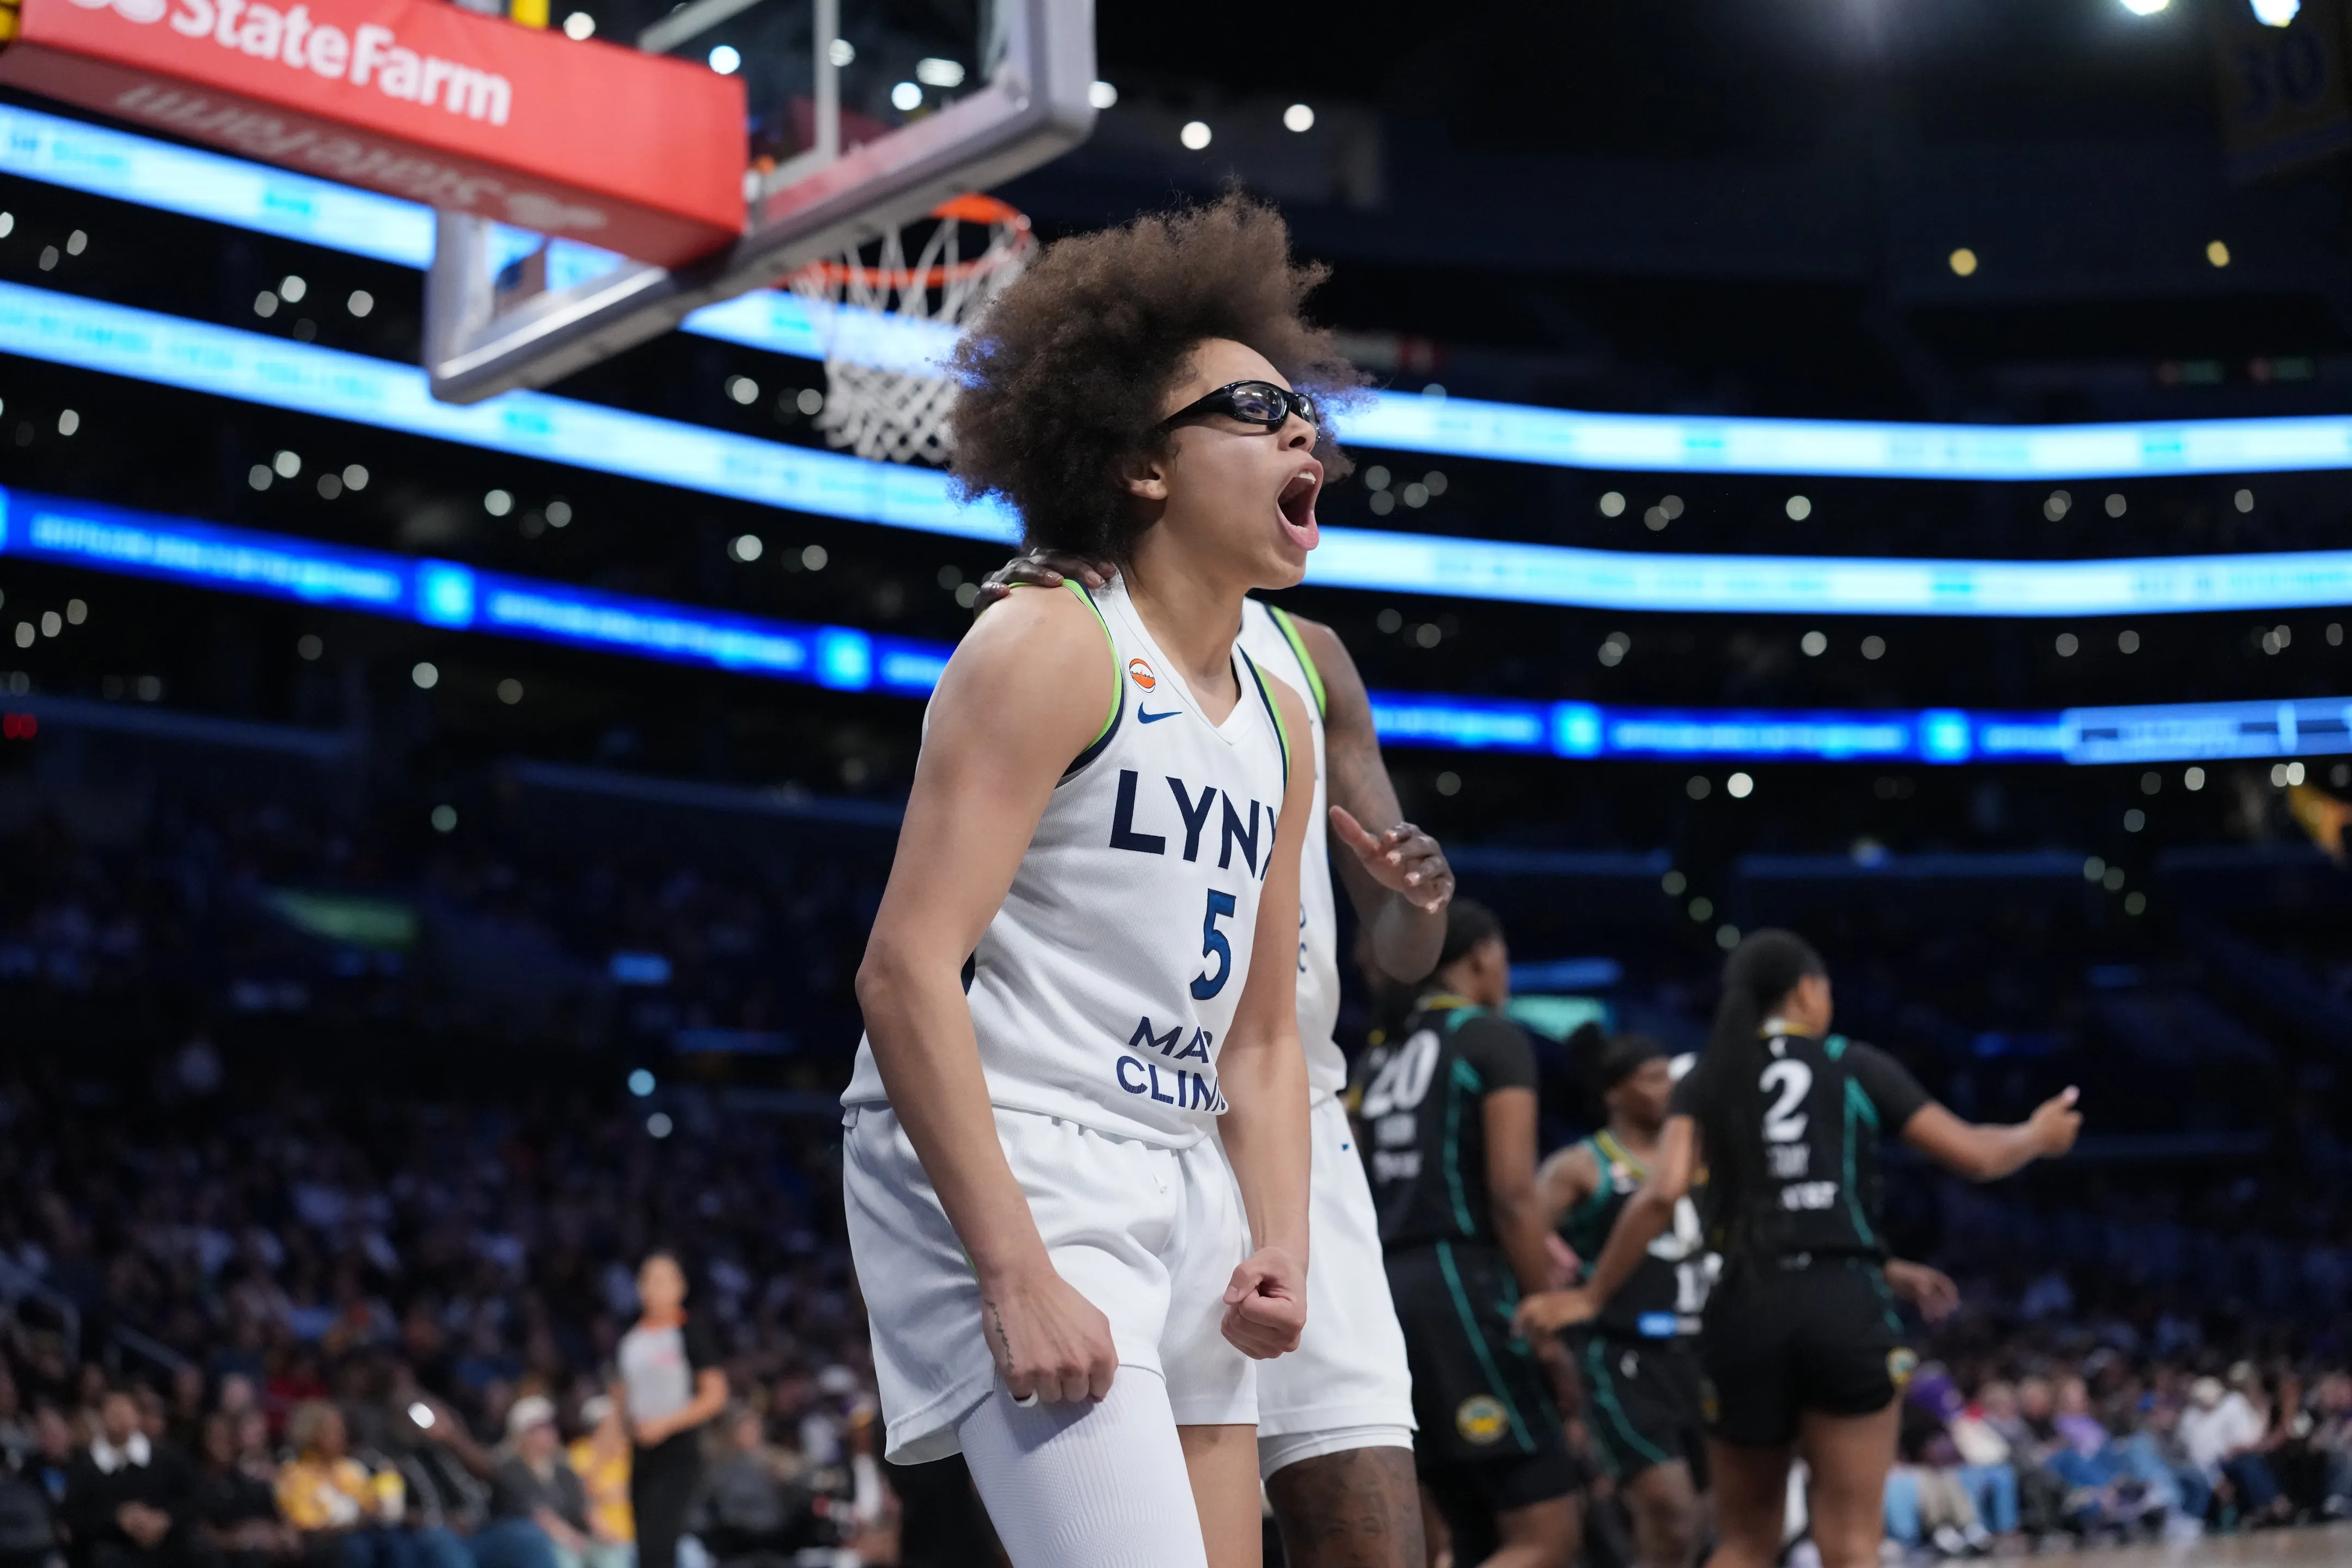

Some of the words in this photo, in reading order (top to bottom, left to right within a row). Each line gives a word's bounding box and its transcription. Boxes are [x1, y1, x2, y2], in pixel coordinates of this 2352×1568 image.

[1190, 887, 1237, 1001] 5
[1128, 1016, 1213, 1063] MA
[1362, 1029, 1441, 1118] 20
[1759, 1058, 1814, 1142] 2
